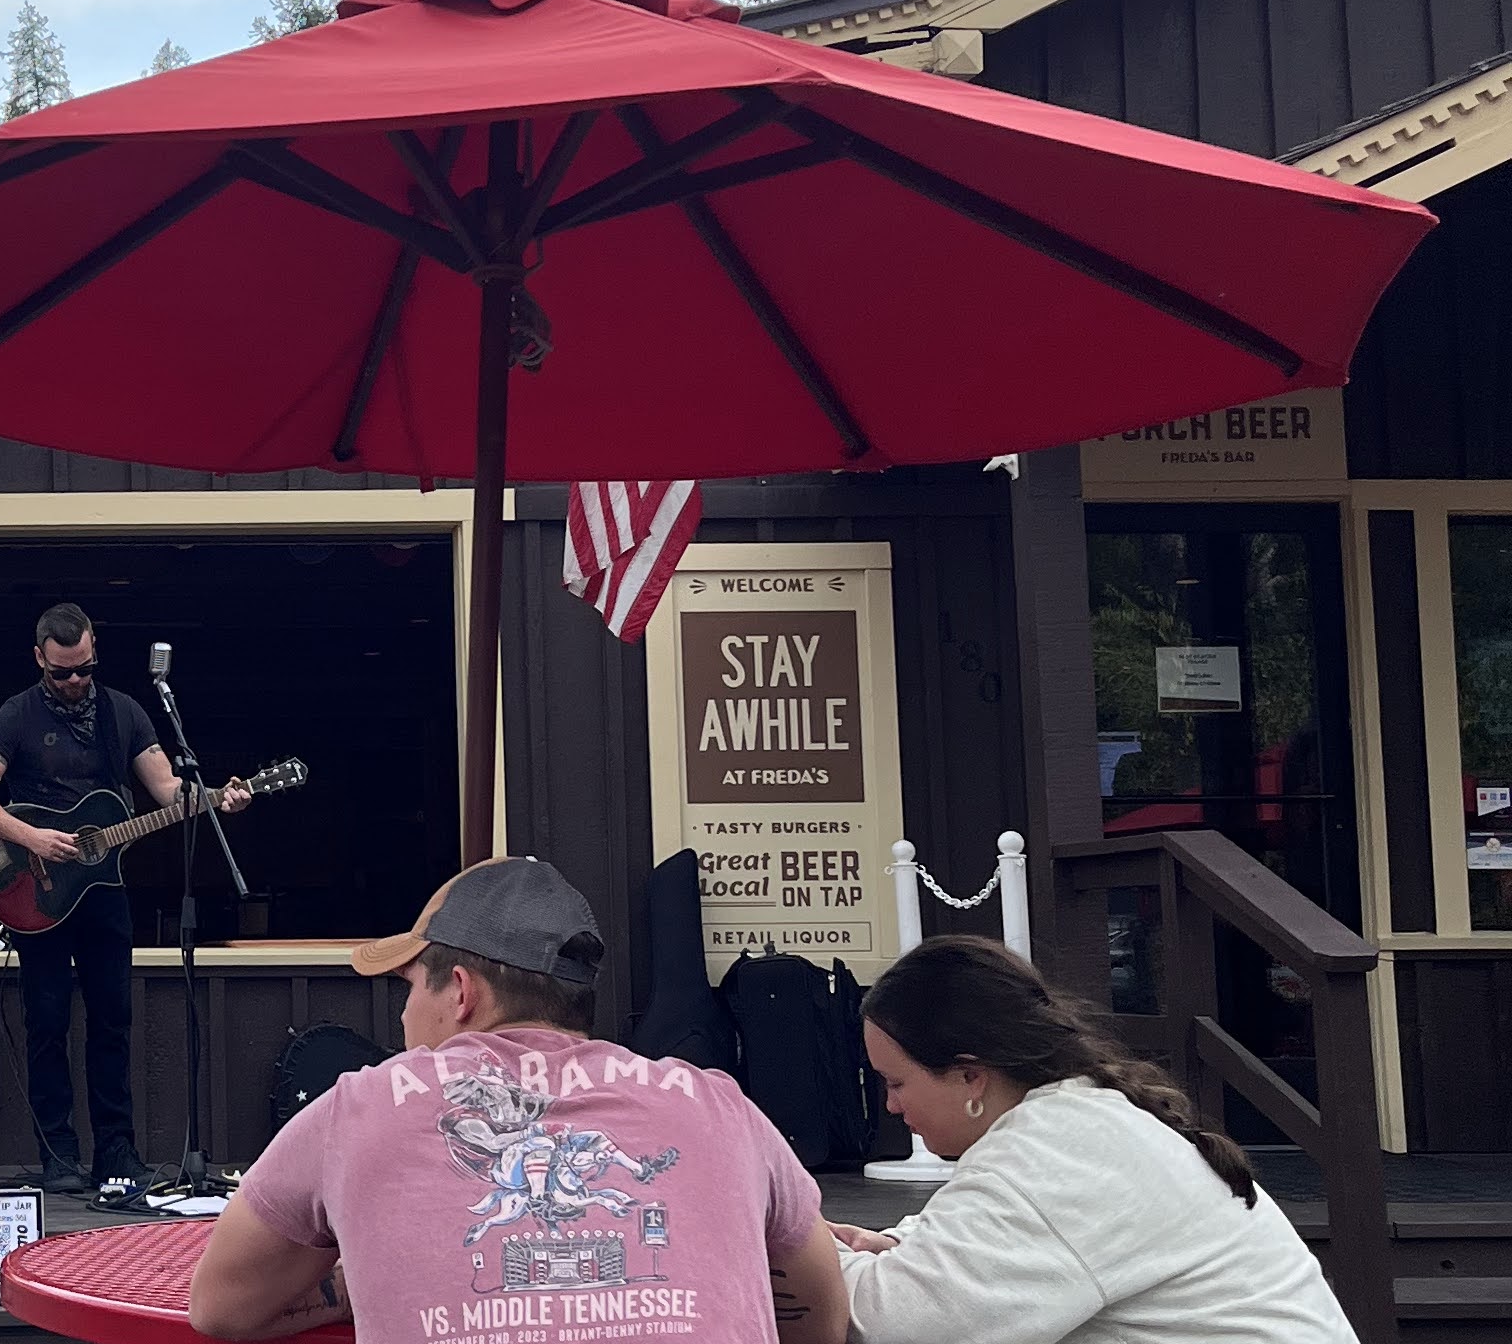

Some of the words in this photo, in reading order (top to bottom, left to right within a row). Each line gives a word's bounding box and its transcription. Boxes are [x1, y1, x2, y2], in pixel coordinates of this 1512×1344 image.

[1226, 407, 1311, 440] BEER
[1161, 450, 1219, 464] FREDA'S
[1224, 451, 1255, 463] BAR
[721, 578, 815, 593] WELCOME
[720, 634, 821, 688] STAY
[699, 698, 849, 752] AWHILE
[722, 769, 745, 785] AT
[751, 767, 829, 785] FREDA'S
[704, 822, 763, 834] TASTY
[771, 821, 850, 834] BURGERS
[699, 852, 771, 873] Great
[780, 851, 860, 881] BEER
[700, 876, 769, 897] Local
[782, 887, 811, 907] ON
[820, 886, 862, 907] TAP
[712, 931, 775, 944] RETAIL
[783, 930, 851, 944] LIQUOR
[14, 1200, 32, 1210] JAR
[419, 1306, 456, 1338] VS.
[462, 1296, 553, 1331] MIDDLE
[560, 1288, 698, 1324] TENNESSEE
[517, 1330, 547, 1343] 2023
[558, 1322, 642, 1342] BRYANT-DENNY
